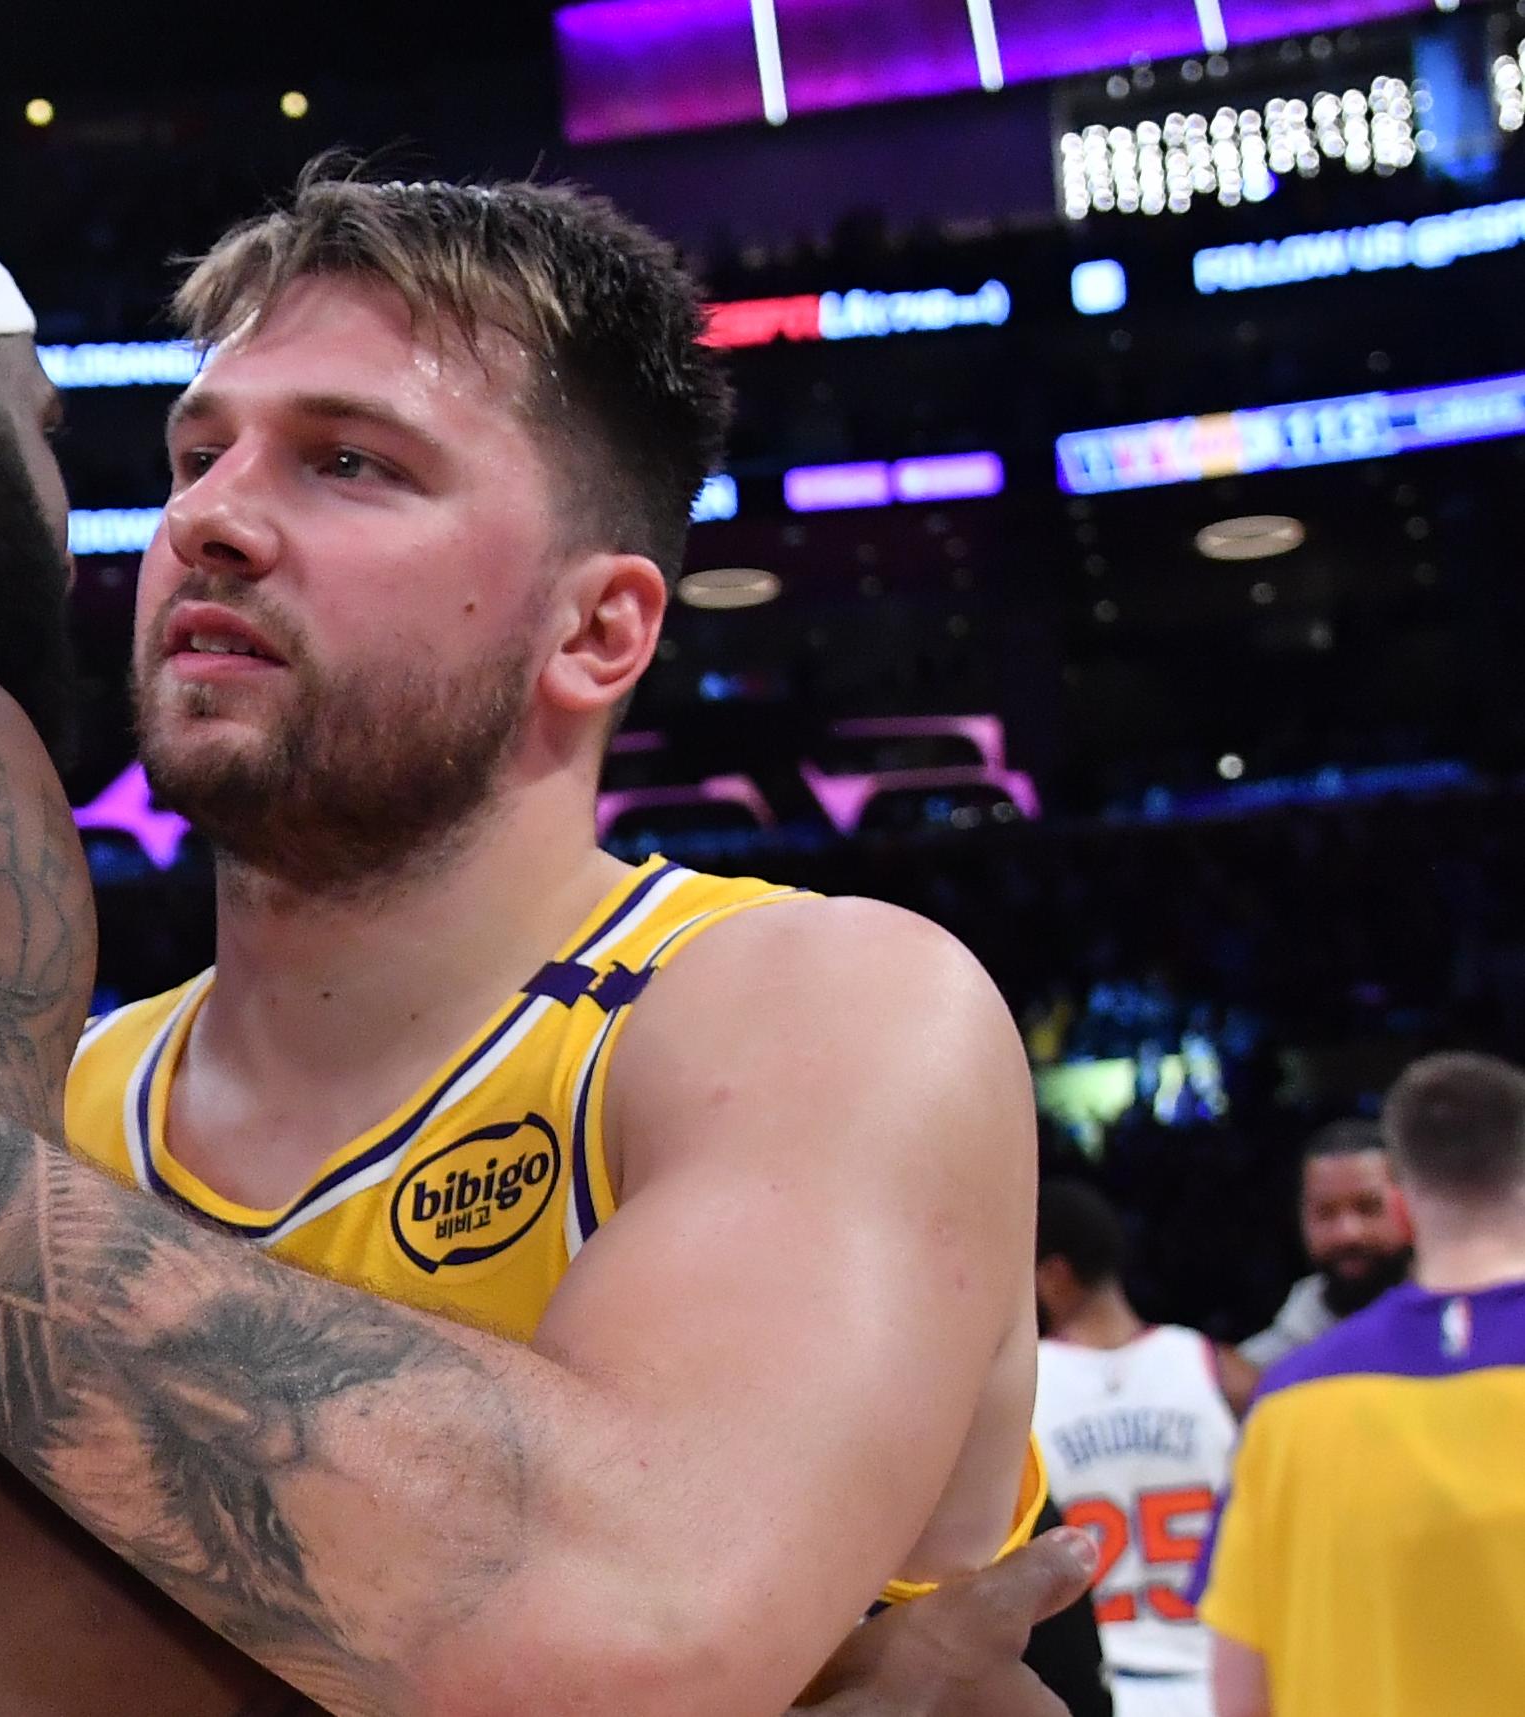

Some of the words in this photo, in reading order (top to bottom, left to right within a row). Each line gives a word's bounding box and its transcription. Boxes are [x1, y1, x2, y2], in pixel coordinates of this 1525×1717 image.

[412, 1152, 549, 1221] bibigo
[435, 1206, 491, 1240] 비비고
[1052, 1408, 1199, 1472] BRIDGES
[1064, 1484, 1215, 1627] 25
